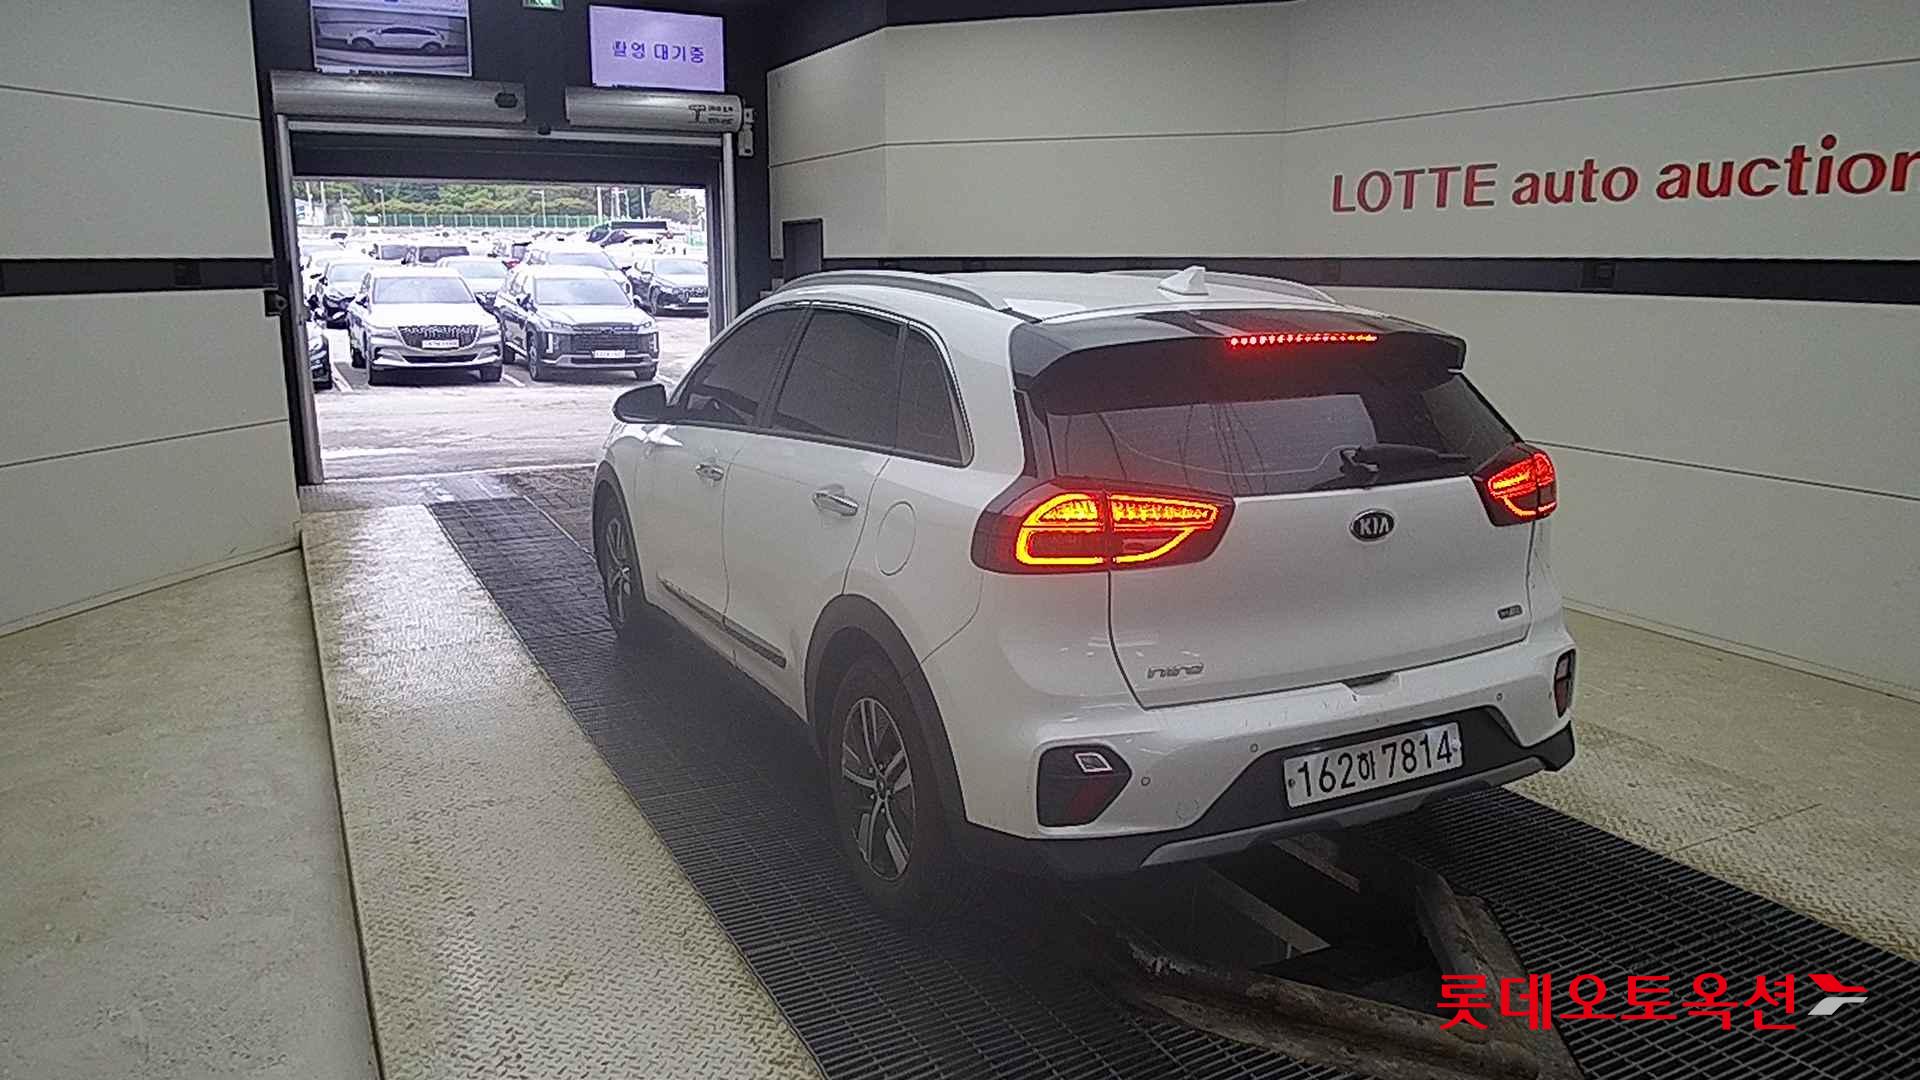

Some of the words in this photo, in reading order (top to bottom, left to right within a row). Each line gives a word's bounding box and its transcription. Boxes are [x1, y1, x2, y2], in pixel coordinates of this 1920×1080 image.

[653, 43, 705, 64] 대기중
[1332, 163, 1498, 213] LOTTE
[1511, 158, 1639, 206] auto
[1359, 516, 1390, 536] KIA
